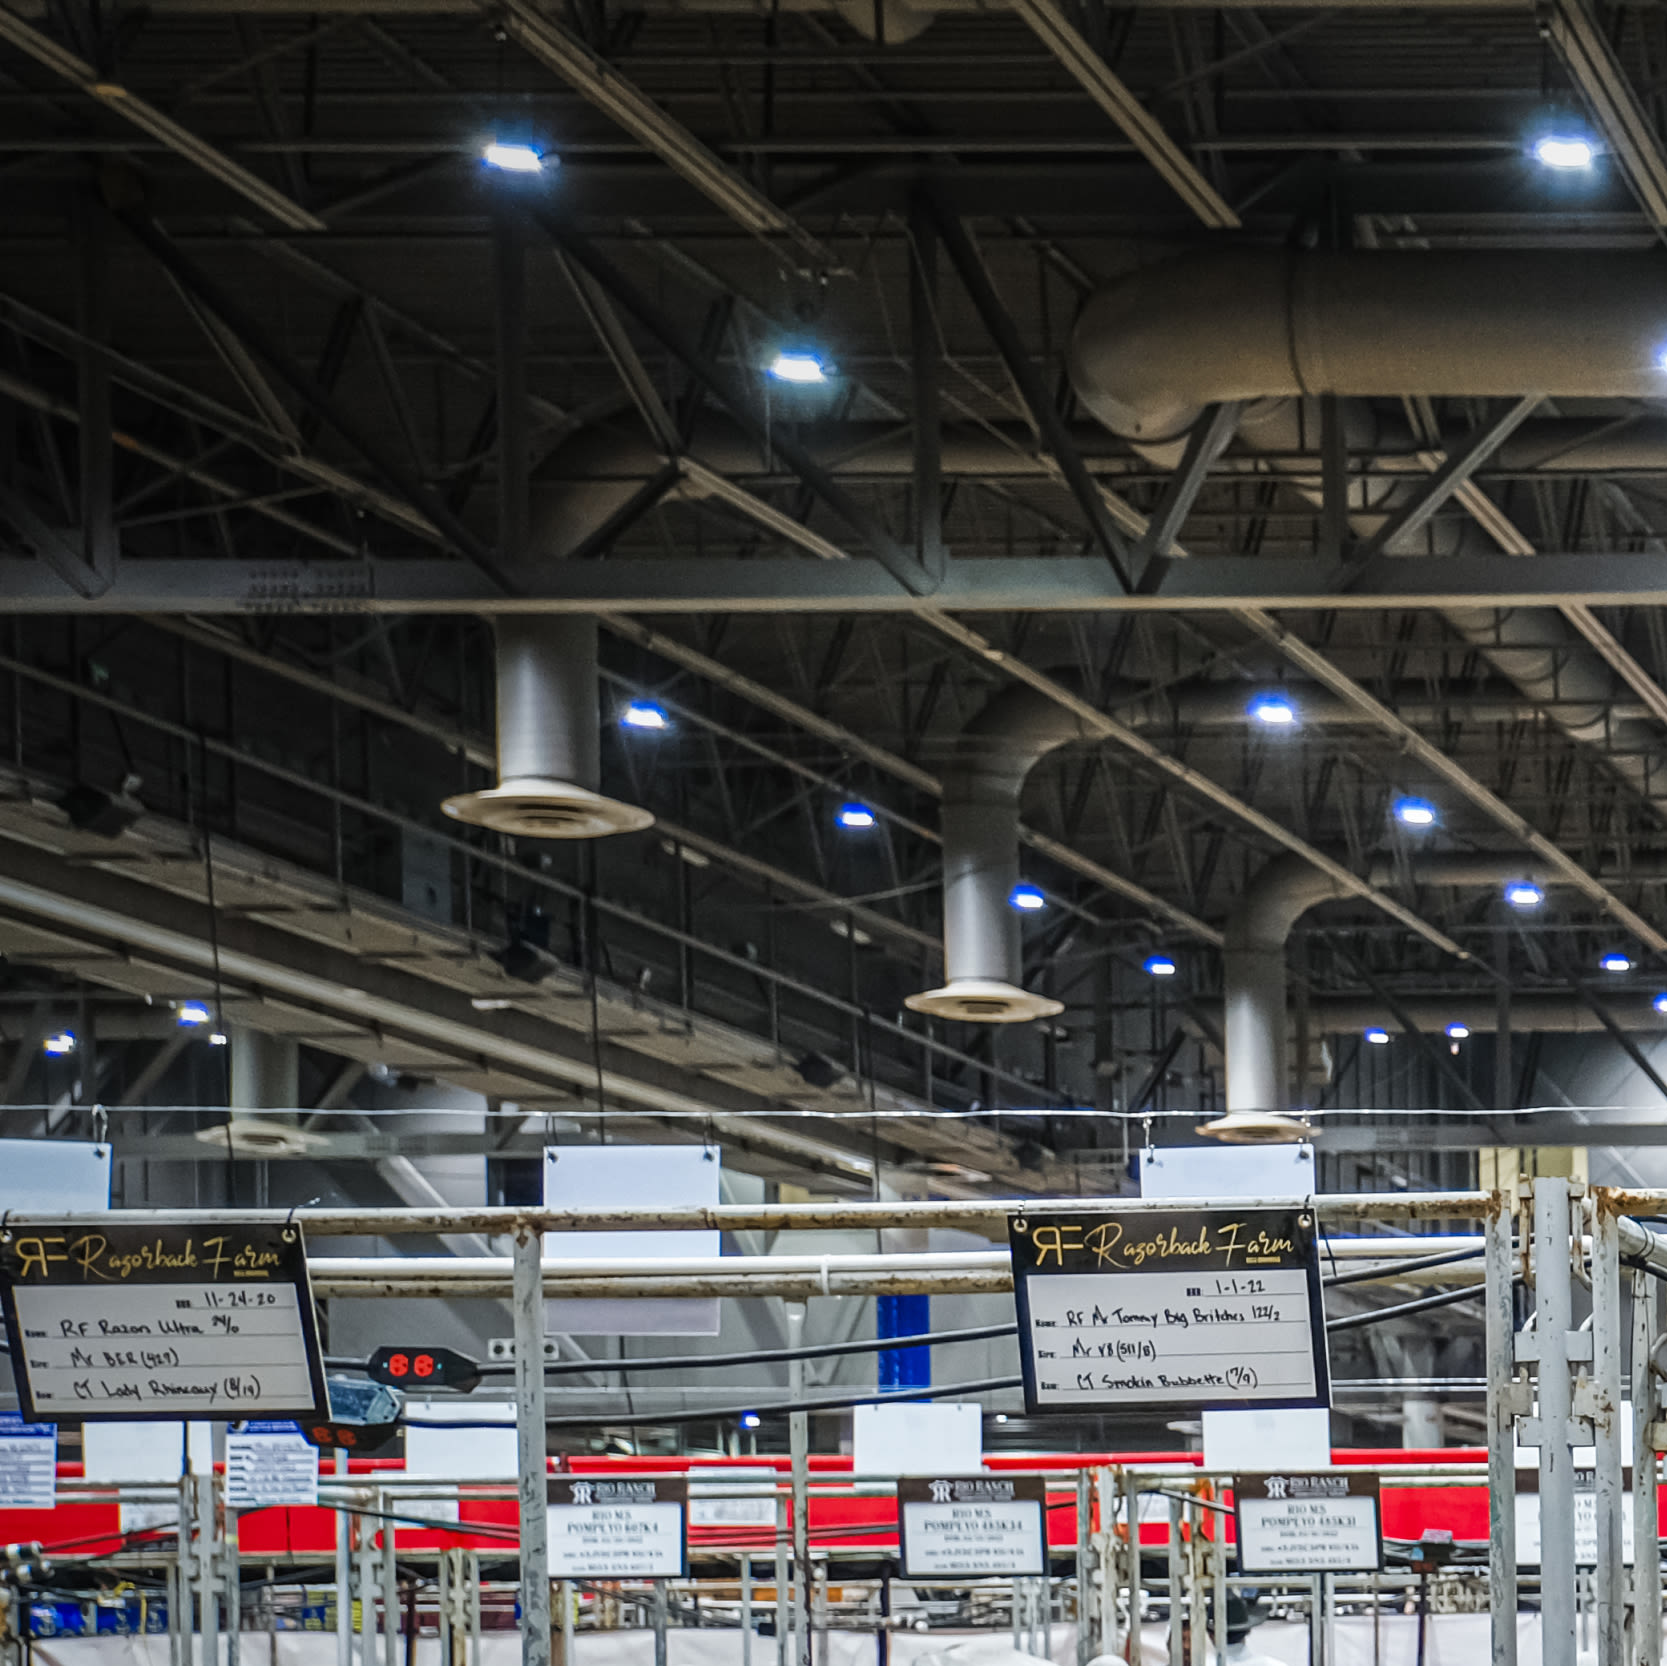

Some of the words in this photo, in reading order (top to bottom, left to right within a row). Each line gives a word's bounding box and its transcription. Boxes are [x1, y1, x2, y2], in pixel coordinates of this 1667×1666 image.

[1083, 1222, 1212, 1270] Razorback
[1215, 1222, 1295, 1268] Farm
[69, 1234, 198, 1280] Razorback
[203, 1235, 280, 1279] Farm
[1216, 1278, 1266, 1295] 1-1-22
[205, 1291, 276, 1307] 11-24-20
[60, 1319, 89, 1337] RF
[158, 1320, 204, 1335] Ultra
[1066, 1310, 1084, 1326] RF
[1112, 1307, 1160, 1328] Tommy
[1164, 1309, 1189, 1328] Big
[1192, 1307, 1246, 1323] Britches
[70, 1346, 93, 1368] Mr
[1072, 1337, 1092, 1358] Mr
[73, 1378, 94, 1400] CT
[100, 1380, 142, 1402] Lady
[1076, 1373, 1094, 1390] CT
[1101, 1374, 1154, 1389] Smokin
